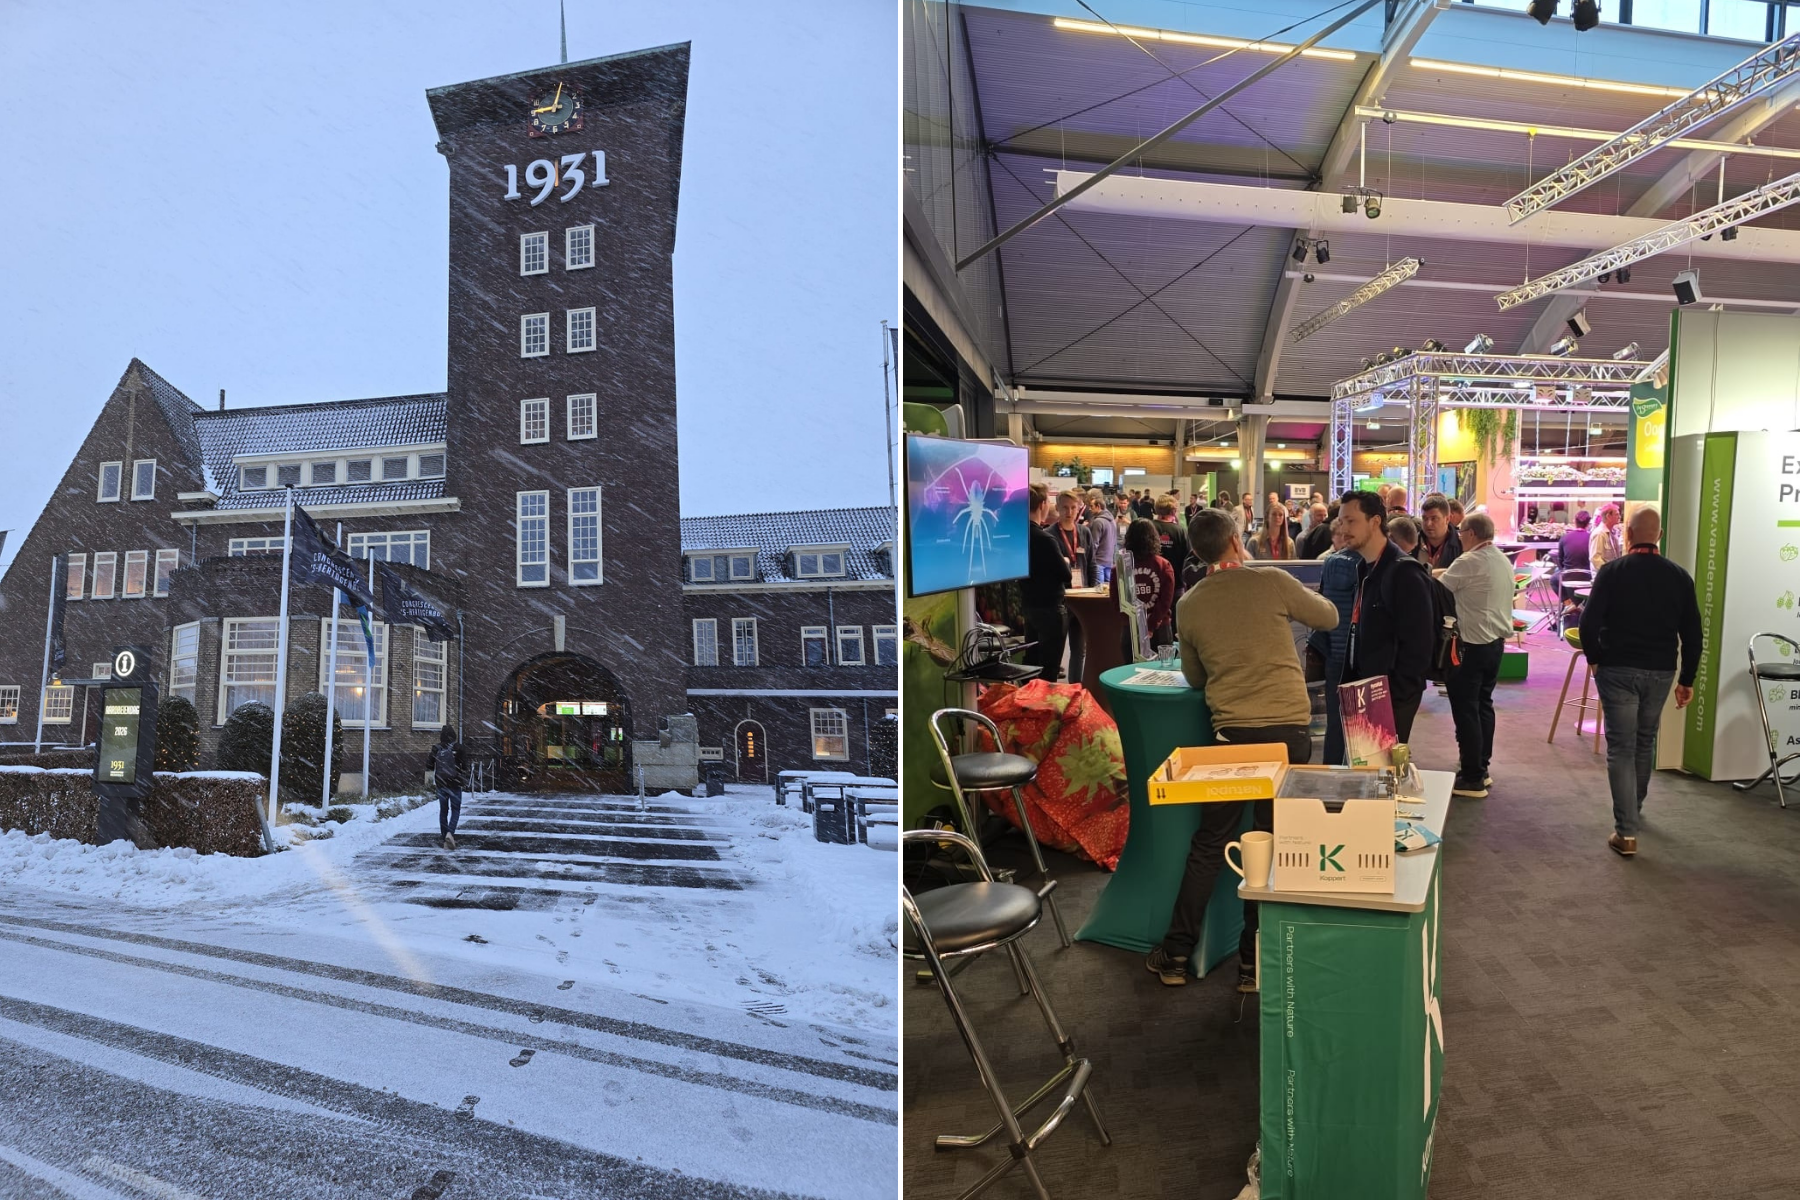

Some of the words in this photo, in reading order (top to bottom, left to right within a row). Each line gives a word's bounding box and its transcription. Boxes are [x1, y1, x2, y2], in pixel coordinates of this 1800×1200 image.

[504, 150, 610, 207] 1931
[1696, 478, 1721, 732] www.vandenelzenplants.com
[1357, 686, 1366, 708] K
[114, 726, 128, 736] 2026
[110, 760, 124, 770] 1931
[1206, 785, 1262, 798] Natupol
[1319, 844, 1346, 872] K
[1286, 926, 1295, 974] Partners
[1286, 976, 1296, 999] with
[1286, 1001, 1296, 1038] Nature
[1286, 1069, 1296, 1116] Partners
[1286, 1118, 1296, 1141] with
[1287, 1143, 1295, 1178] Nature
